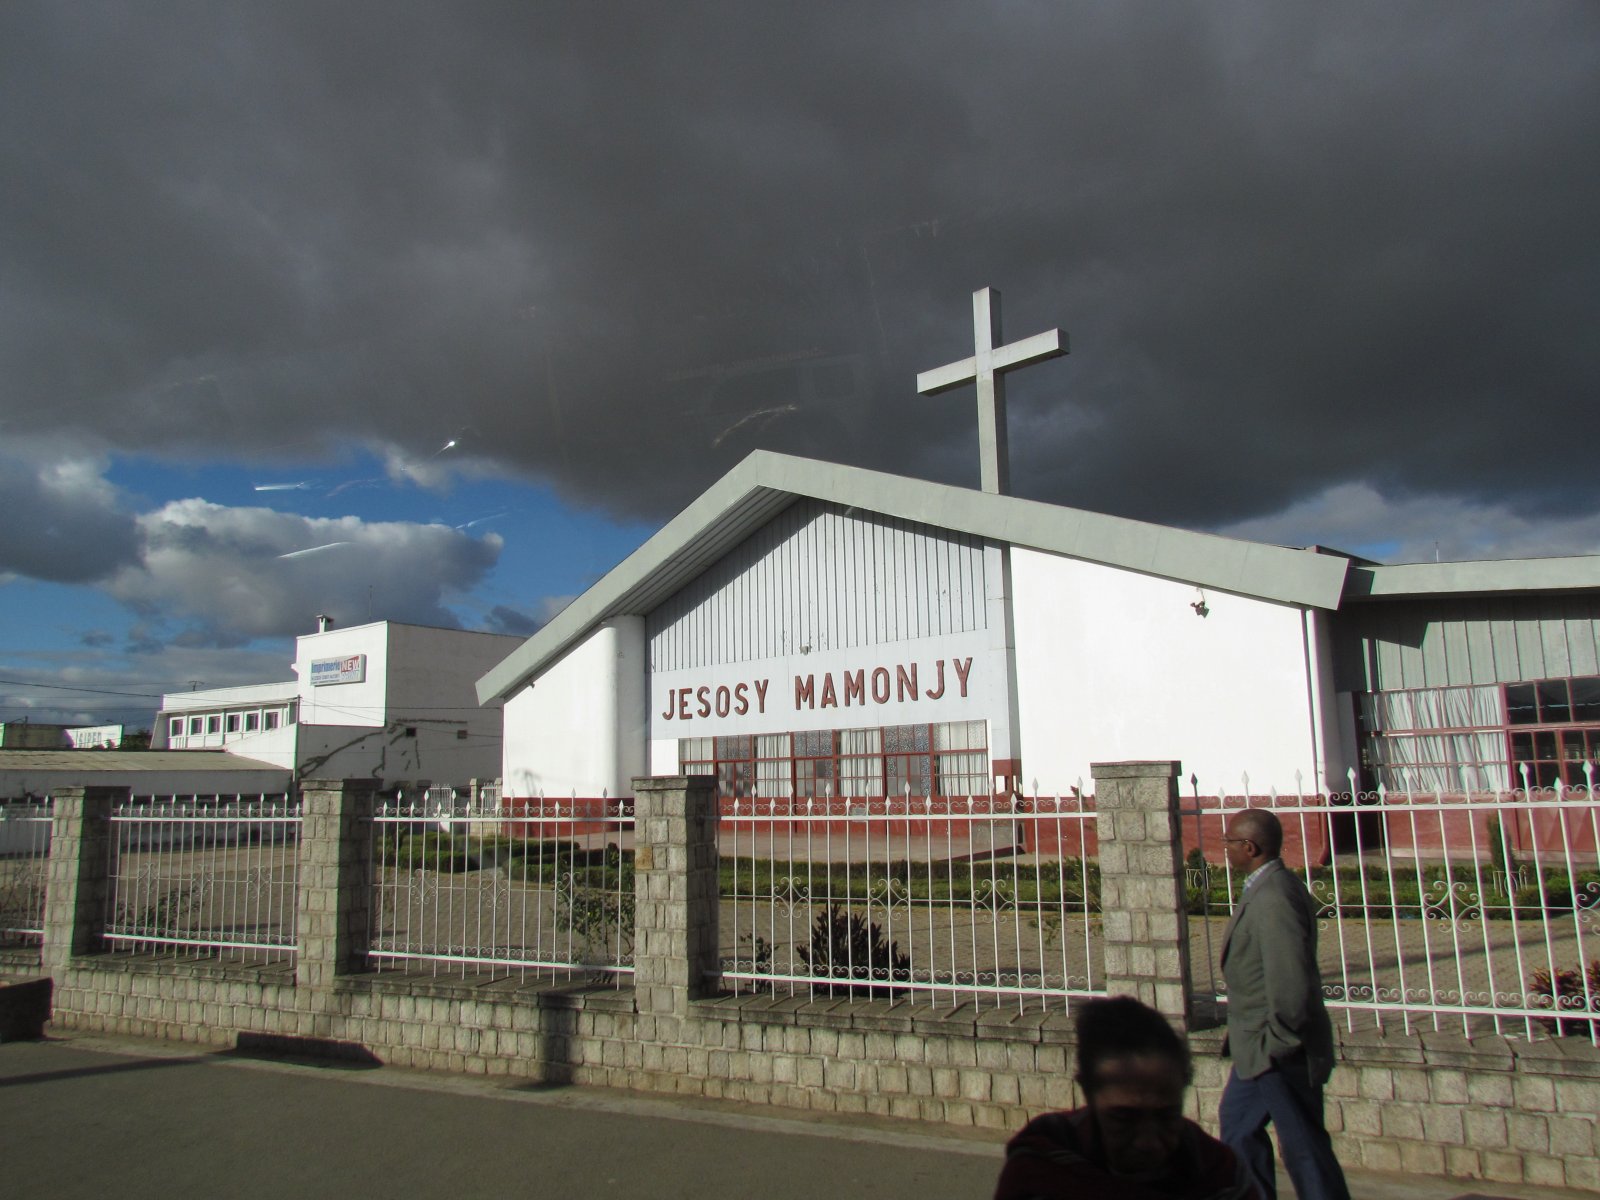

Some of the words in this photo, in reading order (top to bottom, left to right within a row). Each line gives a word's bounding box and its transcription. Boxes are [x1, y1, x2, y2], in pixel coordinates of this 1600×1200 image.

[341, 659, 360, 672] NEW
[662, 679, 769, 721] JESOSY
[795, 657, 973, 710] MAMONJY
